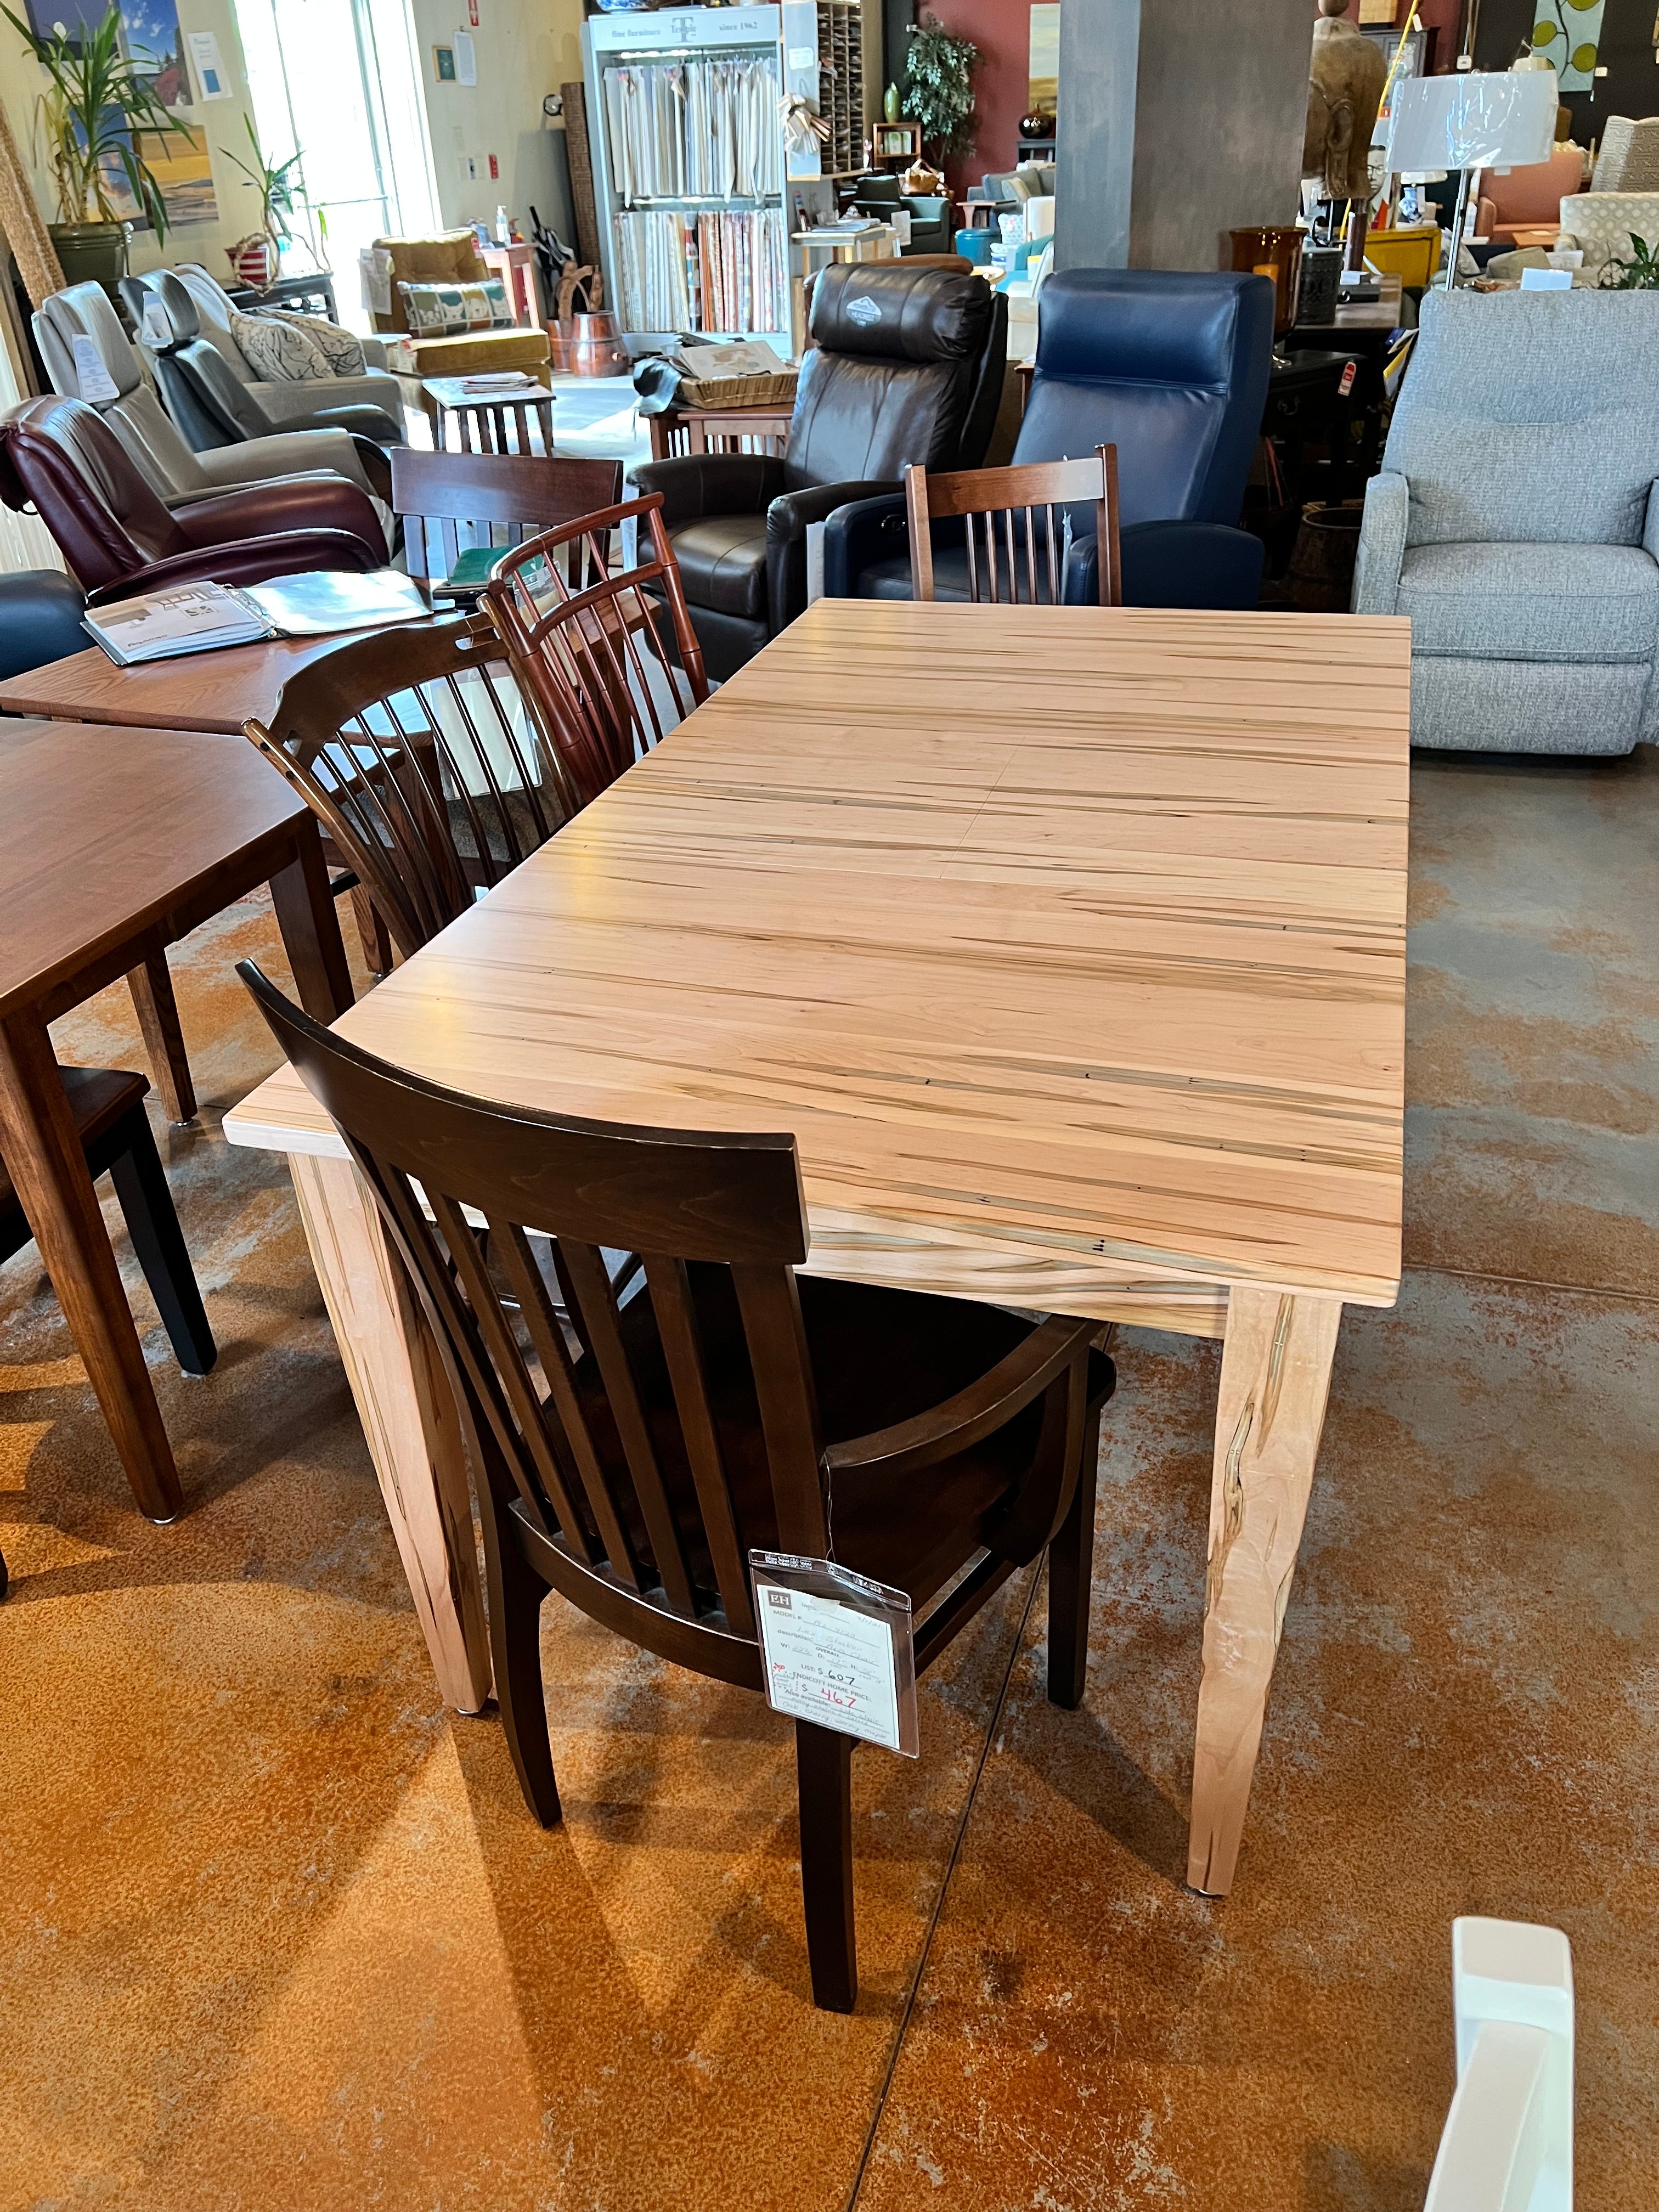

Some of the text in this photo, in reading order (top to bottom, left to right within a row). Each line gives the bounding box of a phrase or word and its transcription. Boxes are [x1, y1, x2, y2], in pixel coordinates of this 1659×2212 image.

[741, 21, 758, 30] 1962
[770, 1594, 789, 1606] EH
[773, 1610, 796, 1619] MODEL
[777, 1629, 813, 1642] description:
[816, 1647, 839, 1657] OVERALL
[828, 1670, 855, 1685] 607
[793, 1672, 825, 1685] ENDICOTT
[828, 1683, 848, 1693] HOME
[851, 1690, 871, 1701] PRICE:
[785, 1689, 799, 1697] Also
[801, 1695, 830, 1706] available:
[802, 1683, 856, 1708] $ 467
